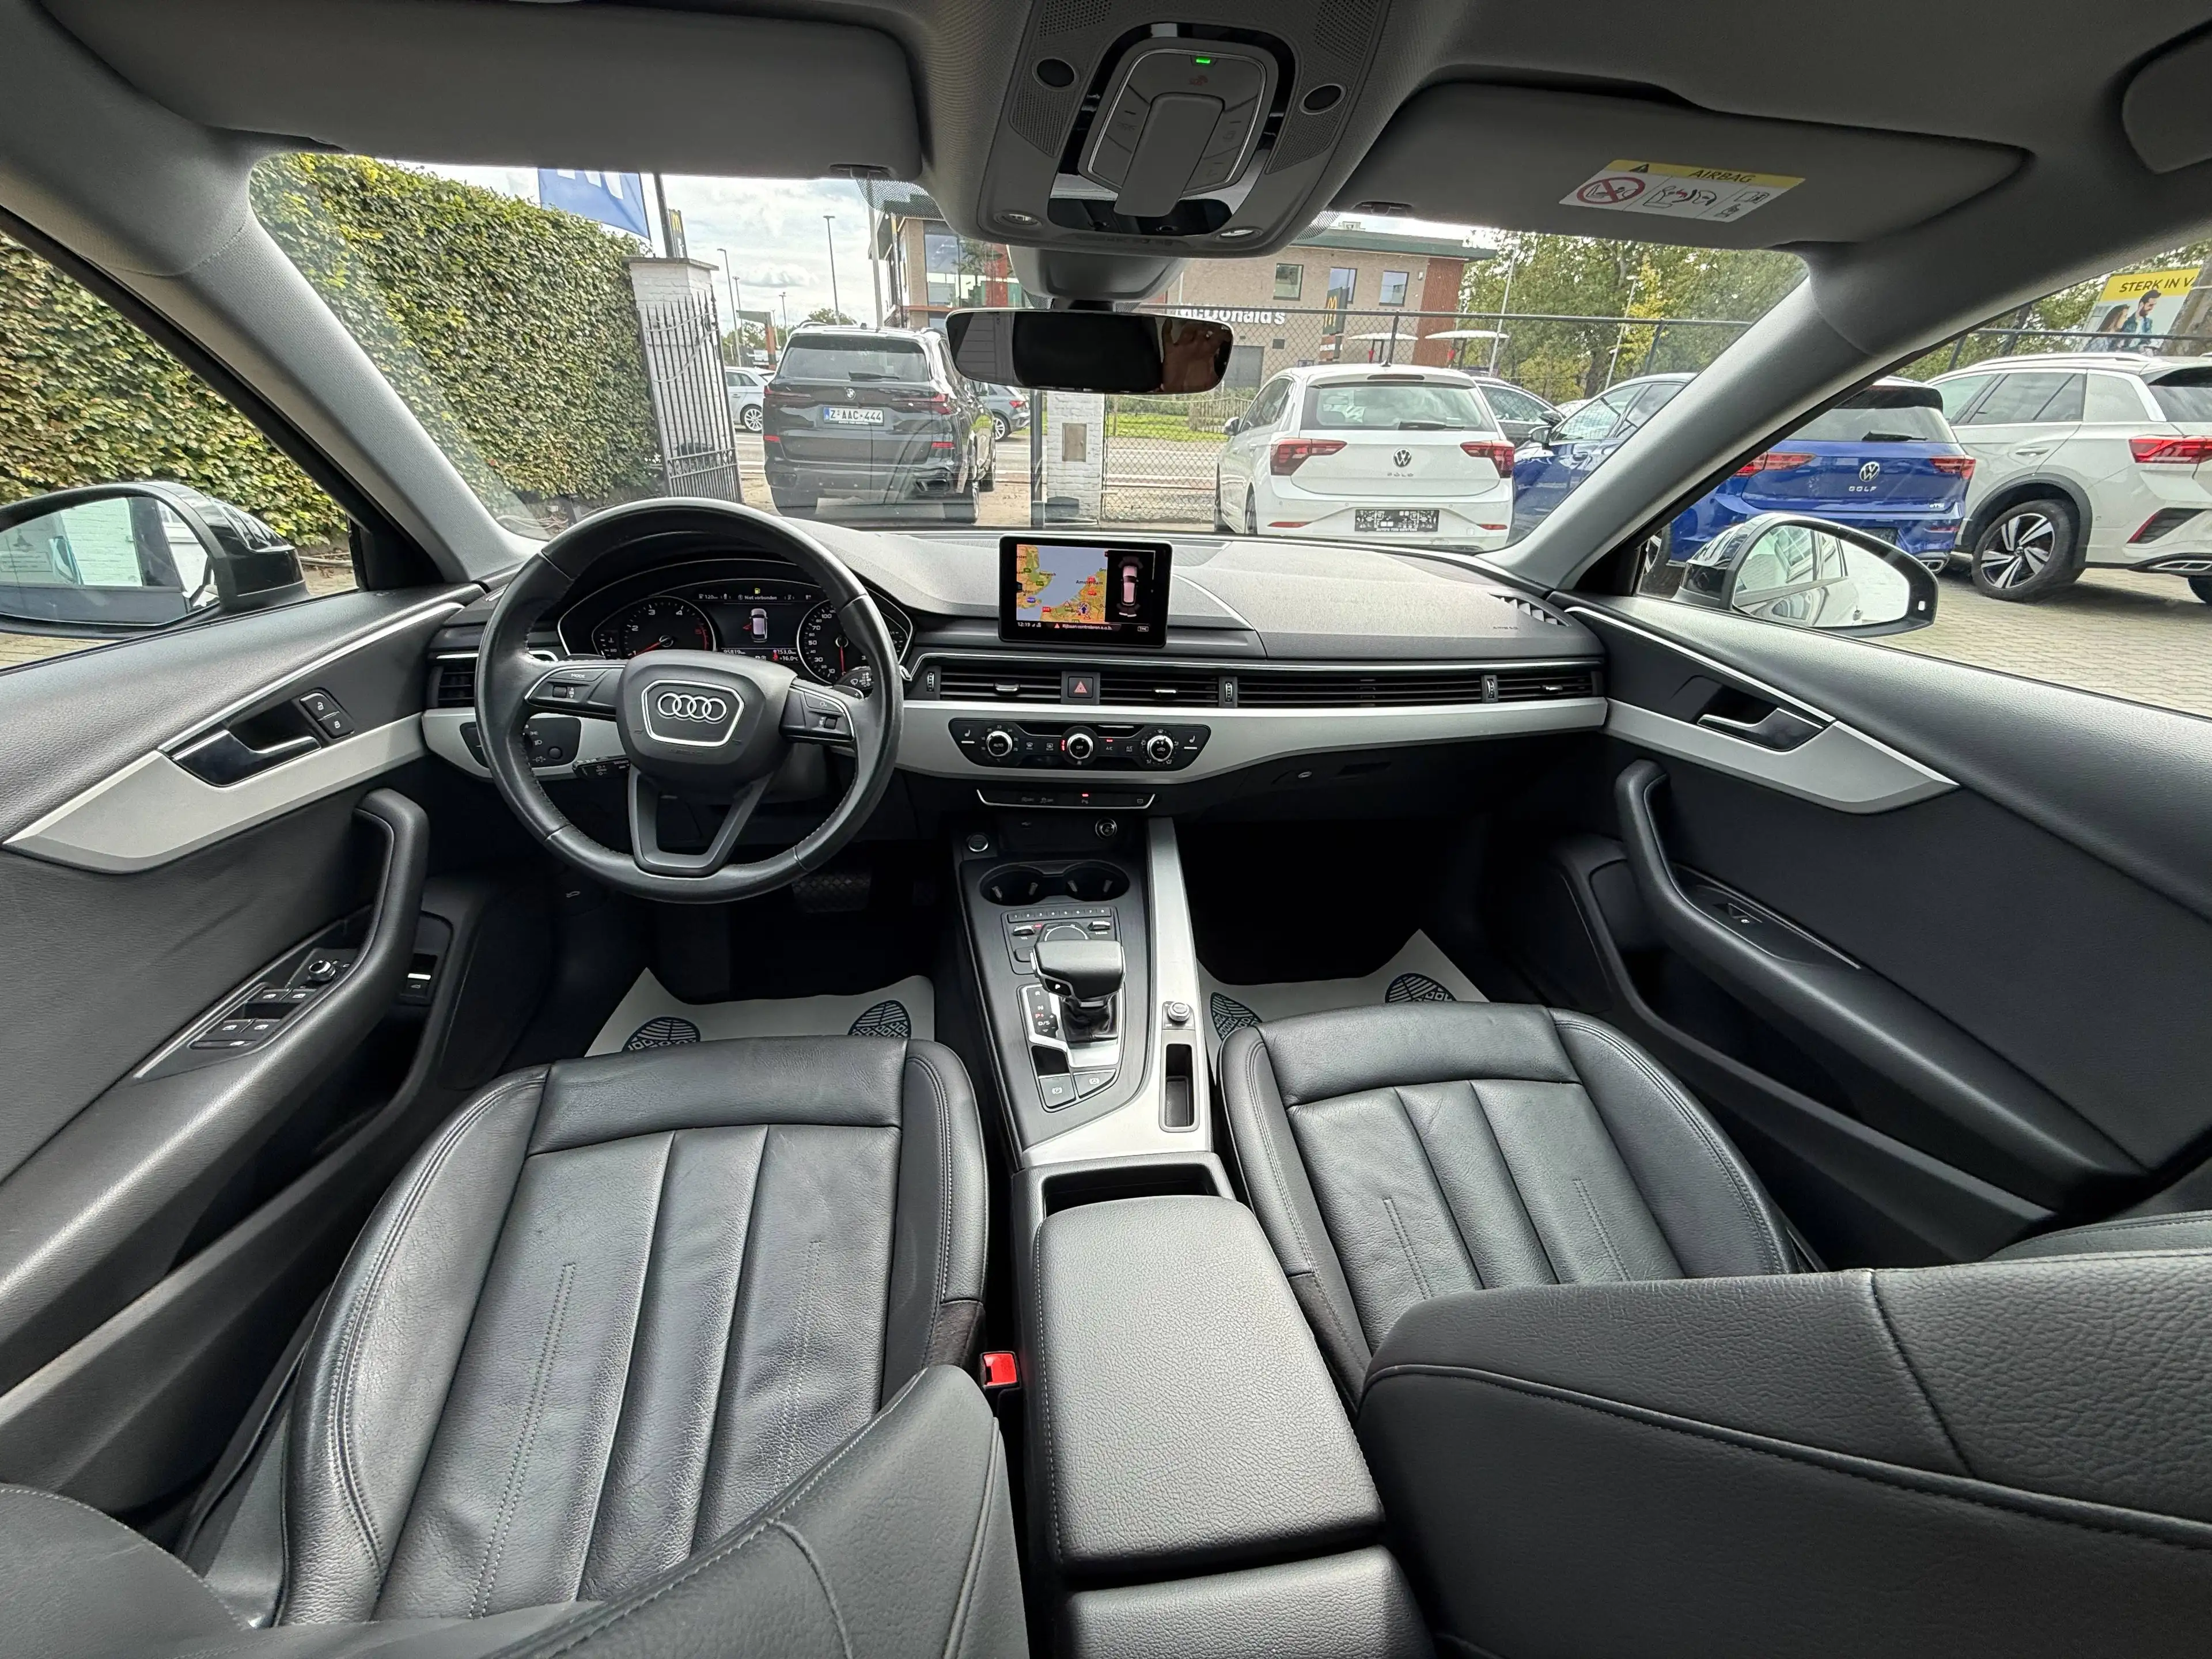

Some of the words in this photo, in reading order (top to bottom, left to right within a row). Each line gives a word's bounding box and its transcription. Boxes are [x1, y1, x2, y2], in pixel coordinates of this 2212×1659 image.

[1688, 169, 1756, 183] AIRBAG
[2119, 279, 2163, 293] STERK
[2164, 278, 2180, 289] IN
